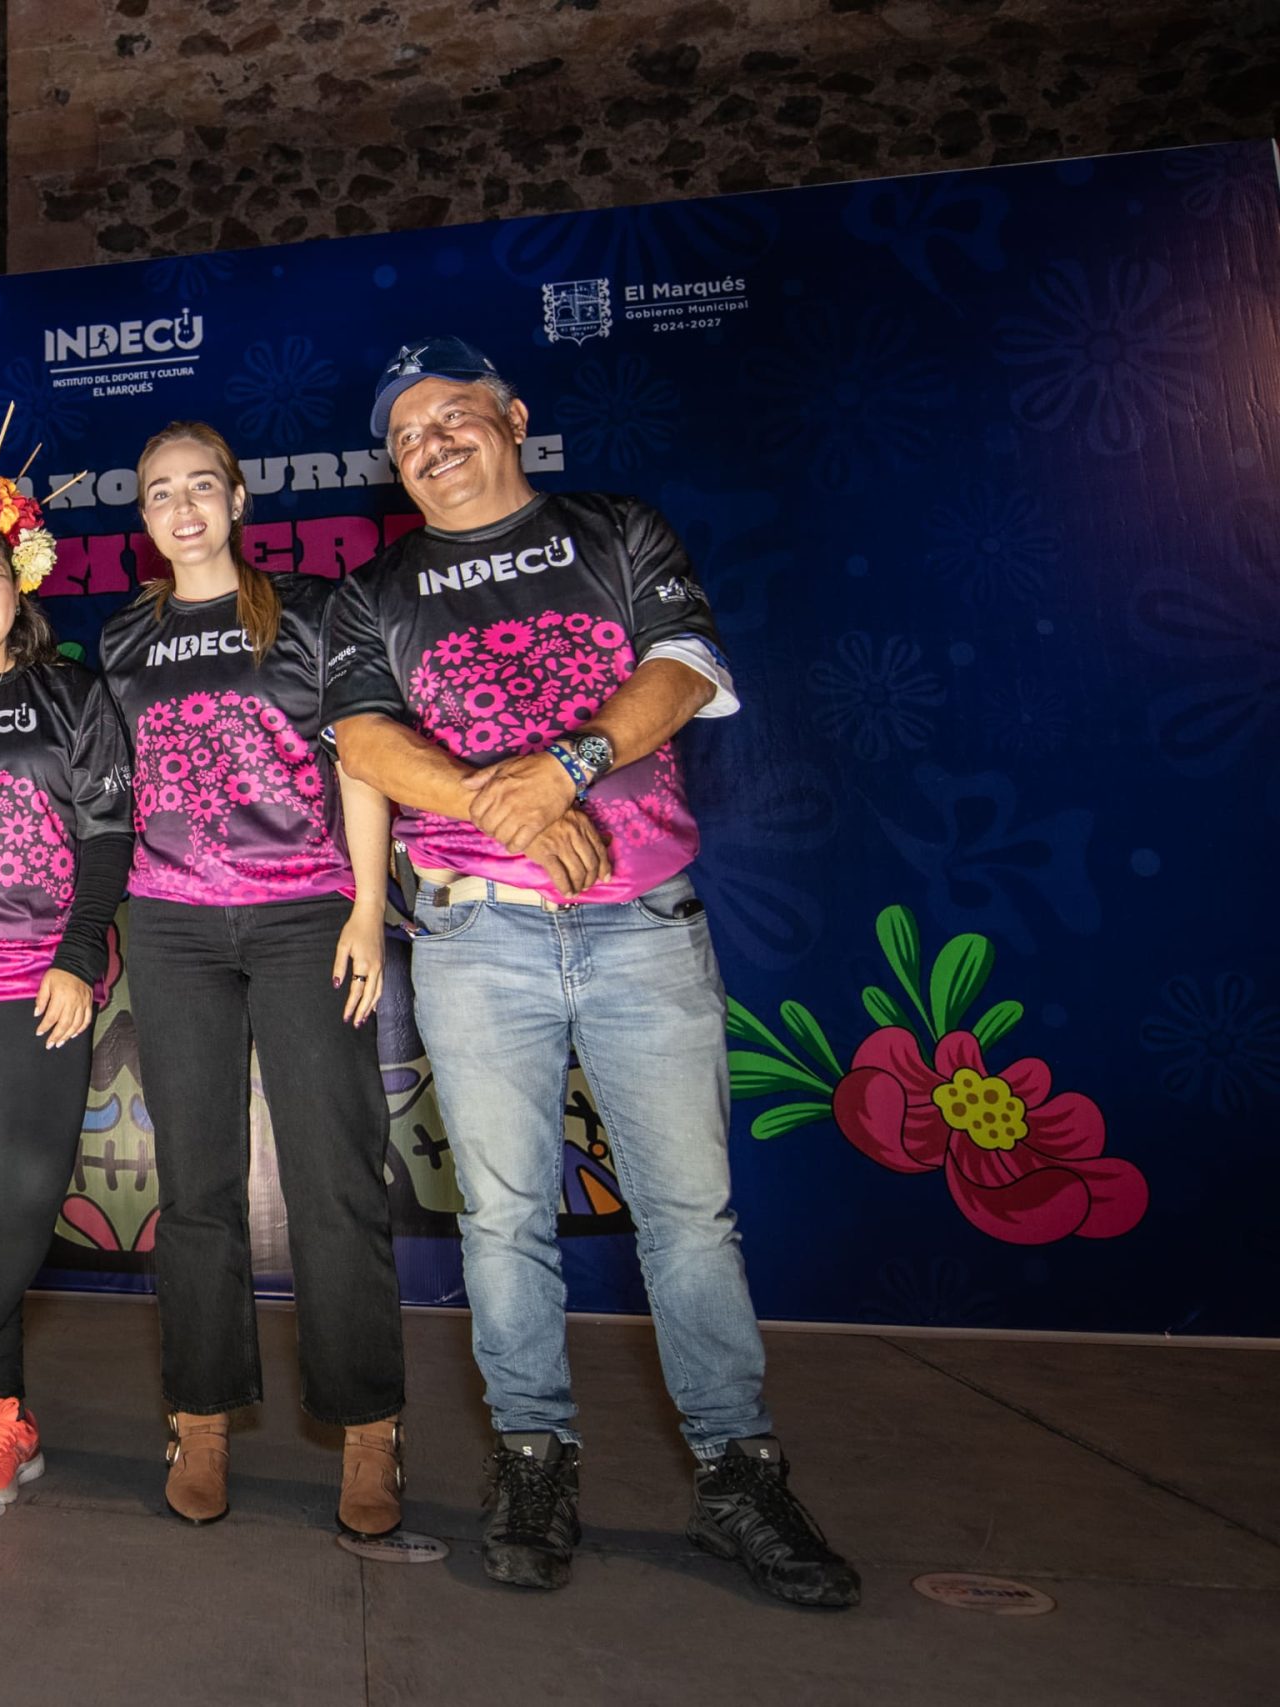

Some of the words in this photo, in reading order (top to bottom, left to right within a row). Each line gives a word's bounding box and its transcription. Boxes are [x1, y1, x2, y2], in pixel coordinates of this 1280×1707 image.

[625, 284, 645, 301] El
[652, 276, 746, 299] Marqués
[625, 307, 683, 320] Gobierno
[688, 300, 749, 314] Municipal
[653, 318, 721, 332] 2024-2027
[53, 376, 93, 388] INSTITUTO
[95, 374, 111, 384] DEL
[112, 370, 148, 382] DEPORTE
[150, 370, 157, 379] Y
[157, 367, 194, 378] CULTURA
[93, 387, 105, 397] EL
[107, 382, 153, 396] MARQUÉS
